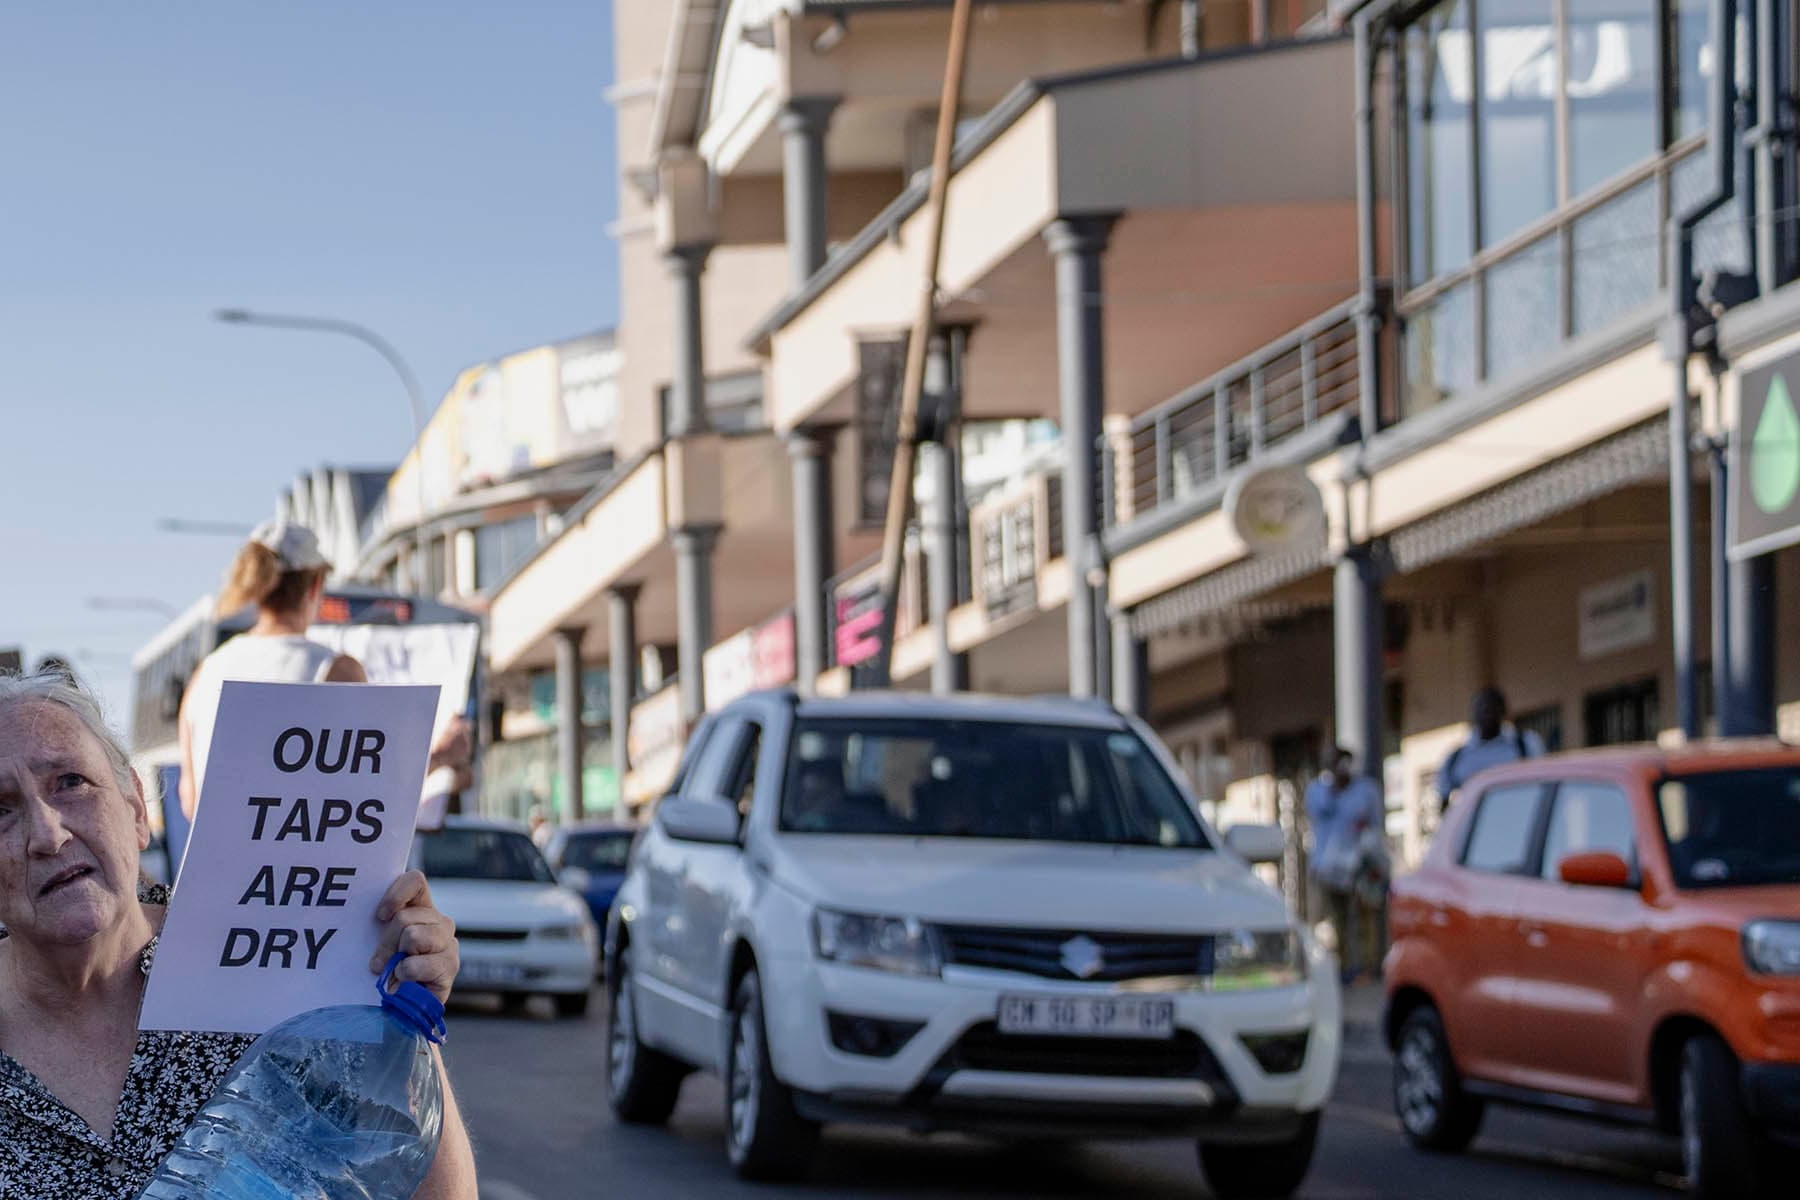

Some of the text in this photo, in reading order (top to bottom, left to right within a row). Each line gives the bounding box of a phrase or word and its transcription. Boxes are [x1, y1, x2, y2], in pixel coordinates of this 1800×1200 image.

[272, 726, 386, 774] OUR
[247, 796, 385, 844] TAPS
[237, 864, 357, 907] ARE
[218, 927, 338, 970] DRY
